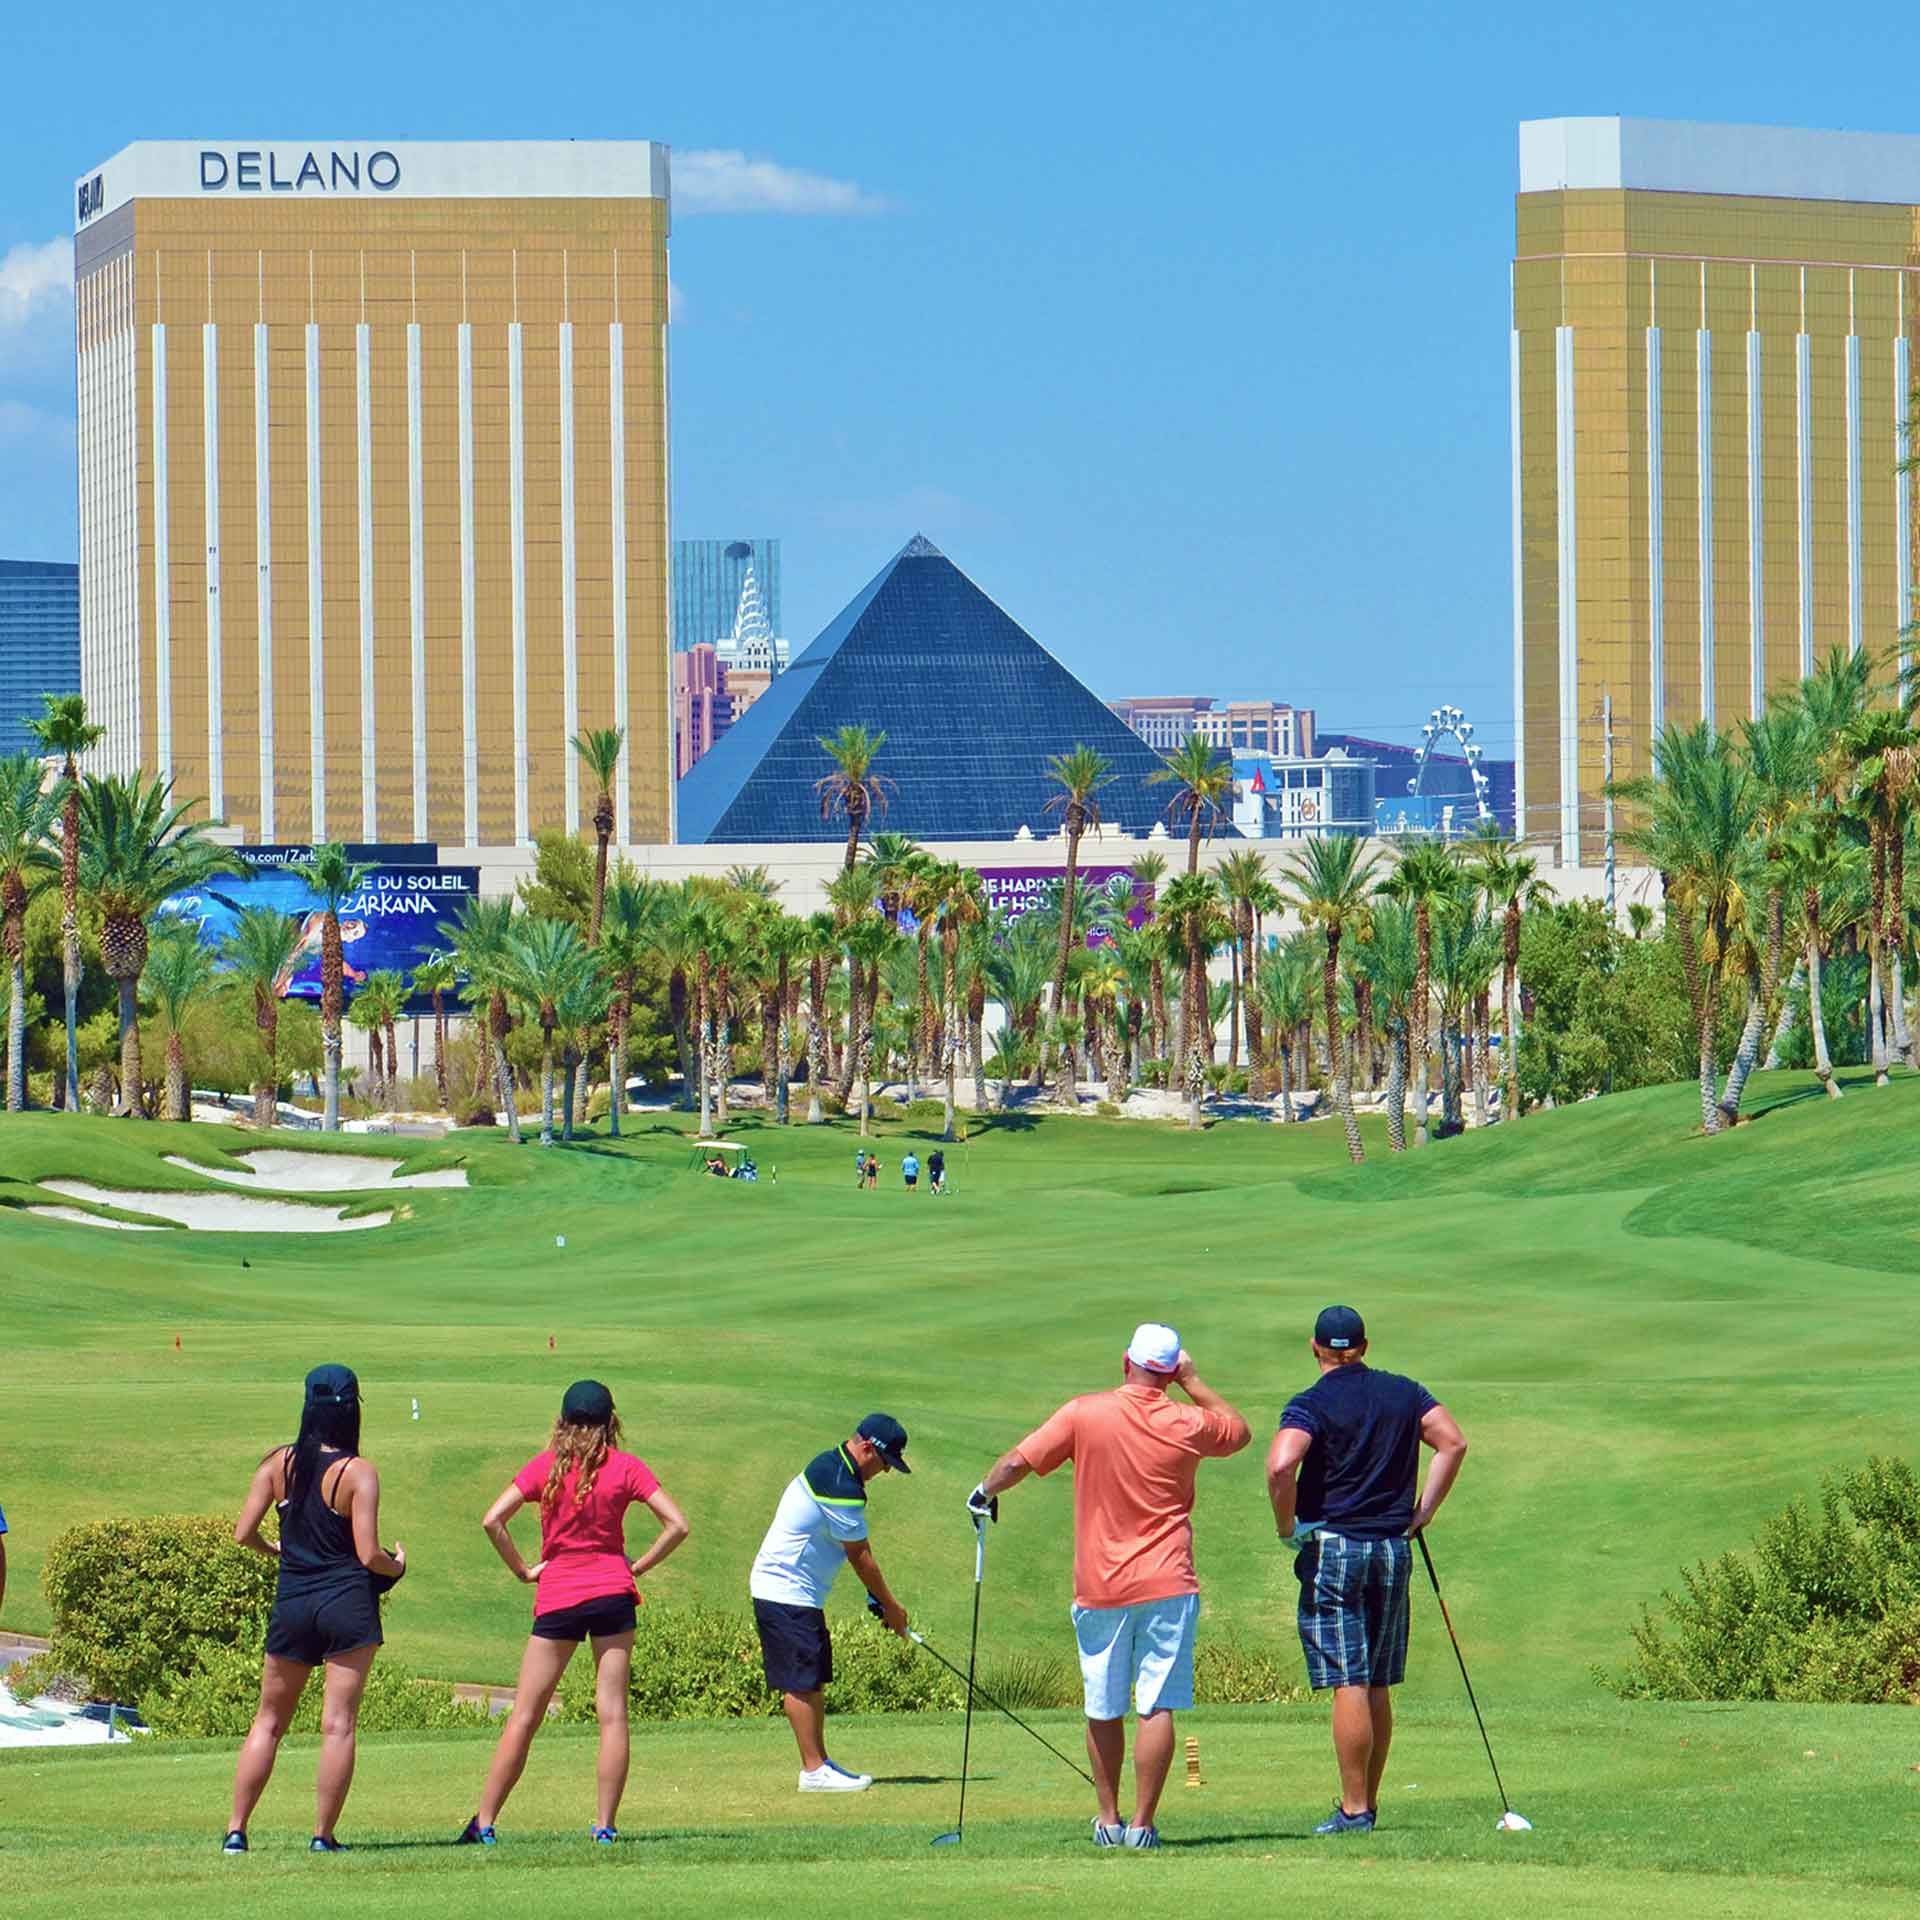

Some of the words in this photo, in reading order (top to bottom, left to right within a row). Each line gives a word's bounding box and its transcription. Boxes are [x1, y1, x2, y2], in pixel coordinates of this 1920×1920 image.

[200, 151, 400, 190] DELANO
[377, 876, 402, 890] DU
[407, 876, 468, 890] SOLEIL
[1002, 878, 1054, 893] HAPP
[339, 892, 438, 917] ZARKANA
